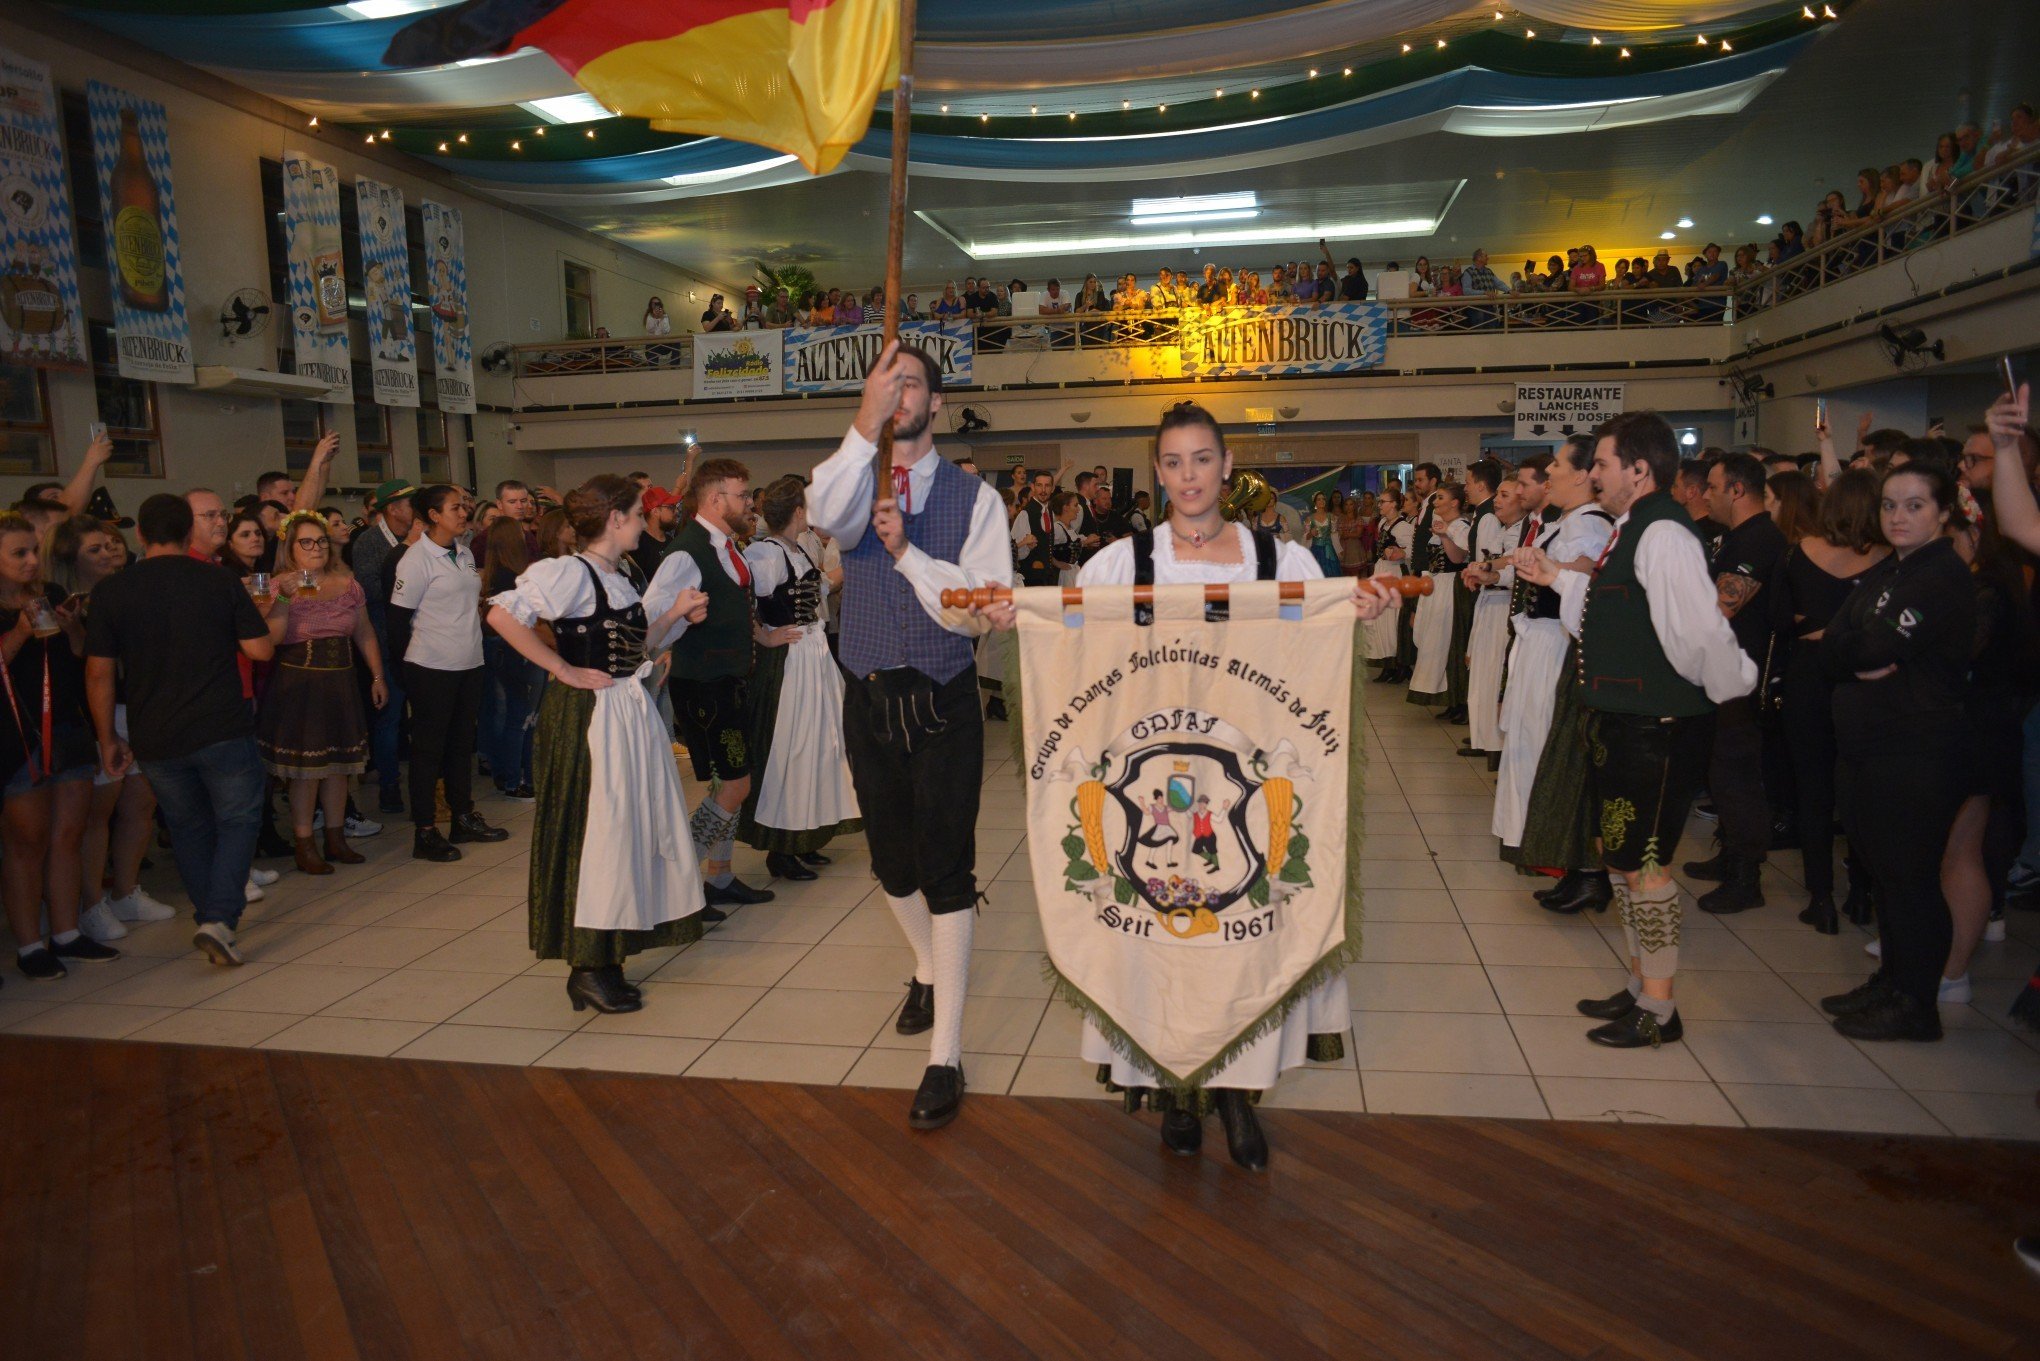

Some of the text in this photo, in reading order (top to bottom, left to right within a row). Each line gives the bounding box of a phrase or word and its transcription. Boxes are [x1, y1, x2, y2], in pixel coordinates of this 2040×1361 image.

[1202, 317, 1366, 364] ALTENBRÜCK
[1518, 387, 1621, 400] RESTAURANTE
[1518, 412, 1566, 421] DRINKS
[1539, 401, 1599, 411] LANCHES
[1031, 638, 1340, 780] Grupo de Danças Folclóricas Alemãs de Feliz
[1098, 905, 1275, 941] Seit 1967
